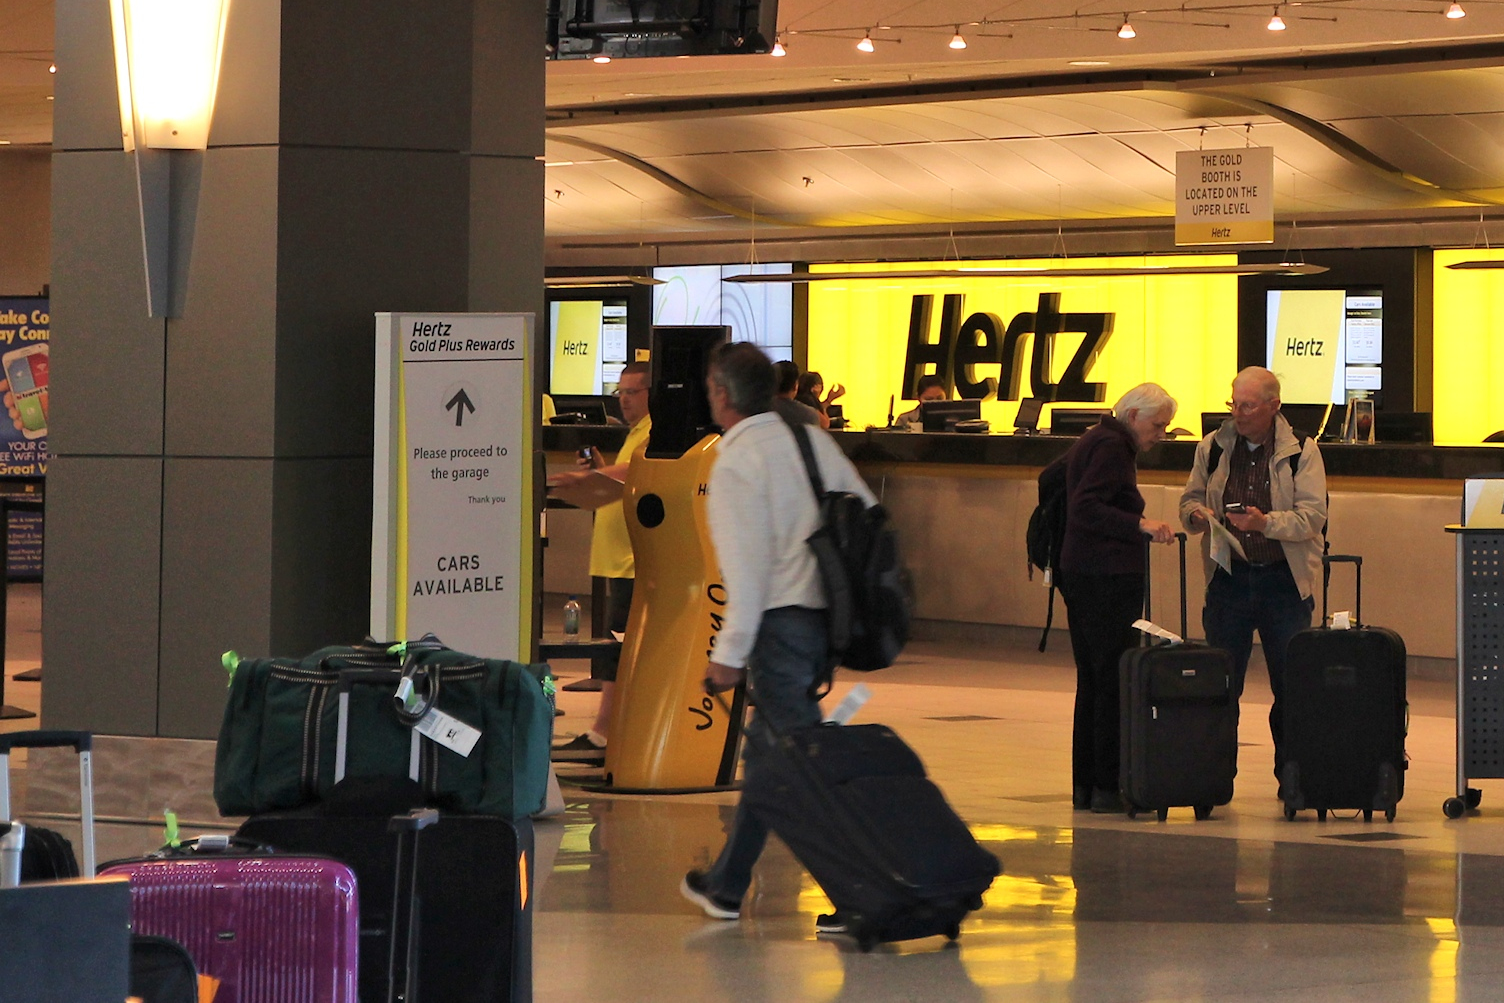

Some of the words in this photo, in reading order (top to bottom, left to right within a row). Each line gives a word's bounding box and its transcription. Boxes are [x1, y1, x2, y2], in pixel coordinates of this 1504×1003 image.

[1201, 155, 1217, 166] THE
[1220, 154, 1242, 166] GOLD
[1201, 171, 1230, 183] BOOTH
[1233, 170, 1241, 181] IS
[1185, 187, 1224, 200] LOCATED
[1226, 187, 1239, 198] ON
[1241, 186, 1258, 197] THE
[1192, 204, 1220, 216] UPPER
[1223, 203, 1250, 215] LEVEL
[1211, 227, 1231, 238] Hertz
[0, 309, 28, 325] ake
[412, 321, 452, 337] Hertz
[409, 339, 436, 352] Gold
[438, 339, 463, 351] Plus
[465, 338, 515, 351] Rewards
[563, 340, 588, 356] Hertz
[901, 292, 1116, 403] Hertz
[1286, 337, 1324, 356] Hertz
[8, 441, 37, 451] YOUR
[413, 447, 447, 459] Please
[450, 445, 493, 461] proceed
[496, 446, 508, 457] to
[430, 468, 449, 479] the
[451, 467, 490, 482] garage
[468, 495, 490, 504] Thank
[491, 496, 506, 505] you
[437, 555, 480, 572] CARS
[413, 576, 504, 597] AVAILABLE
